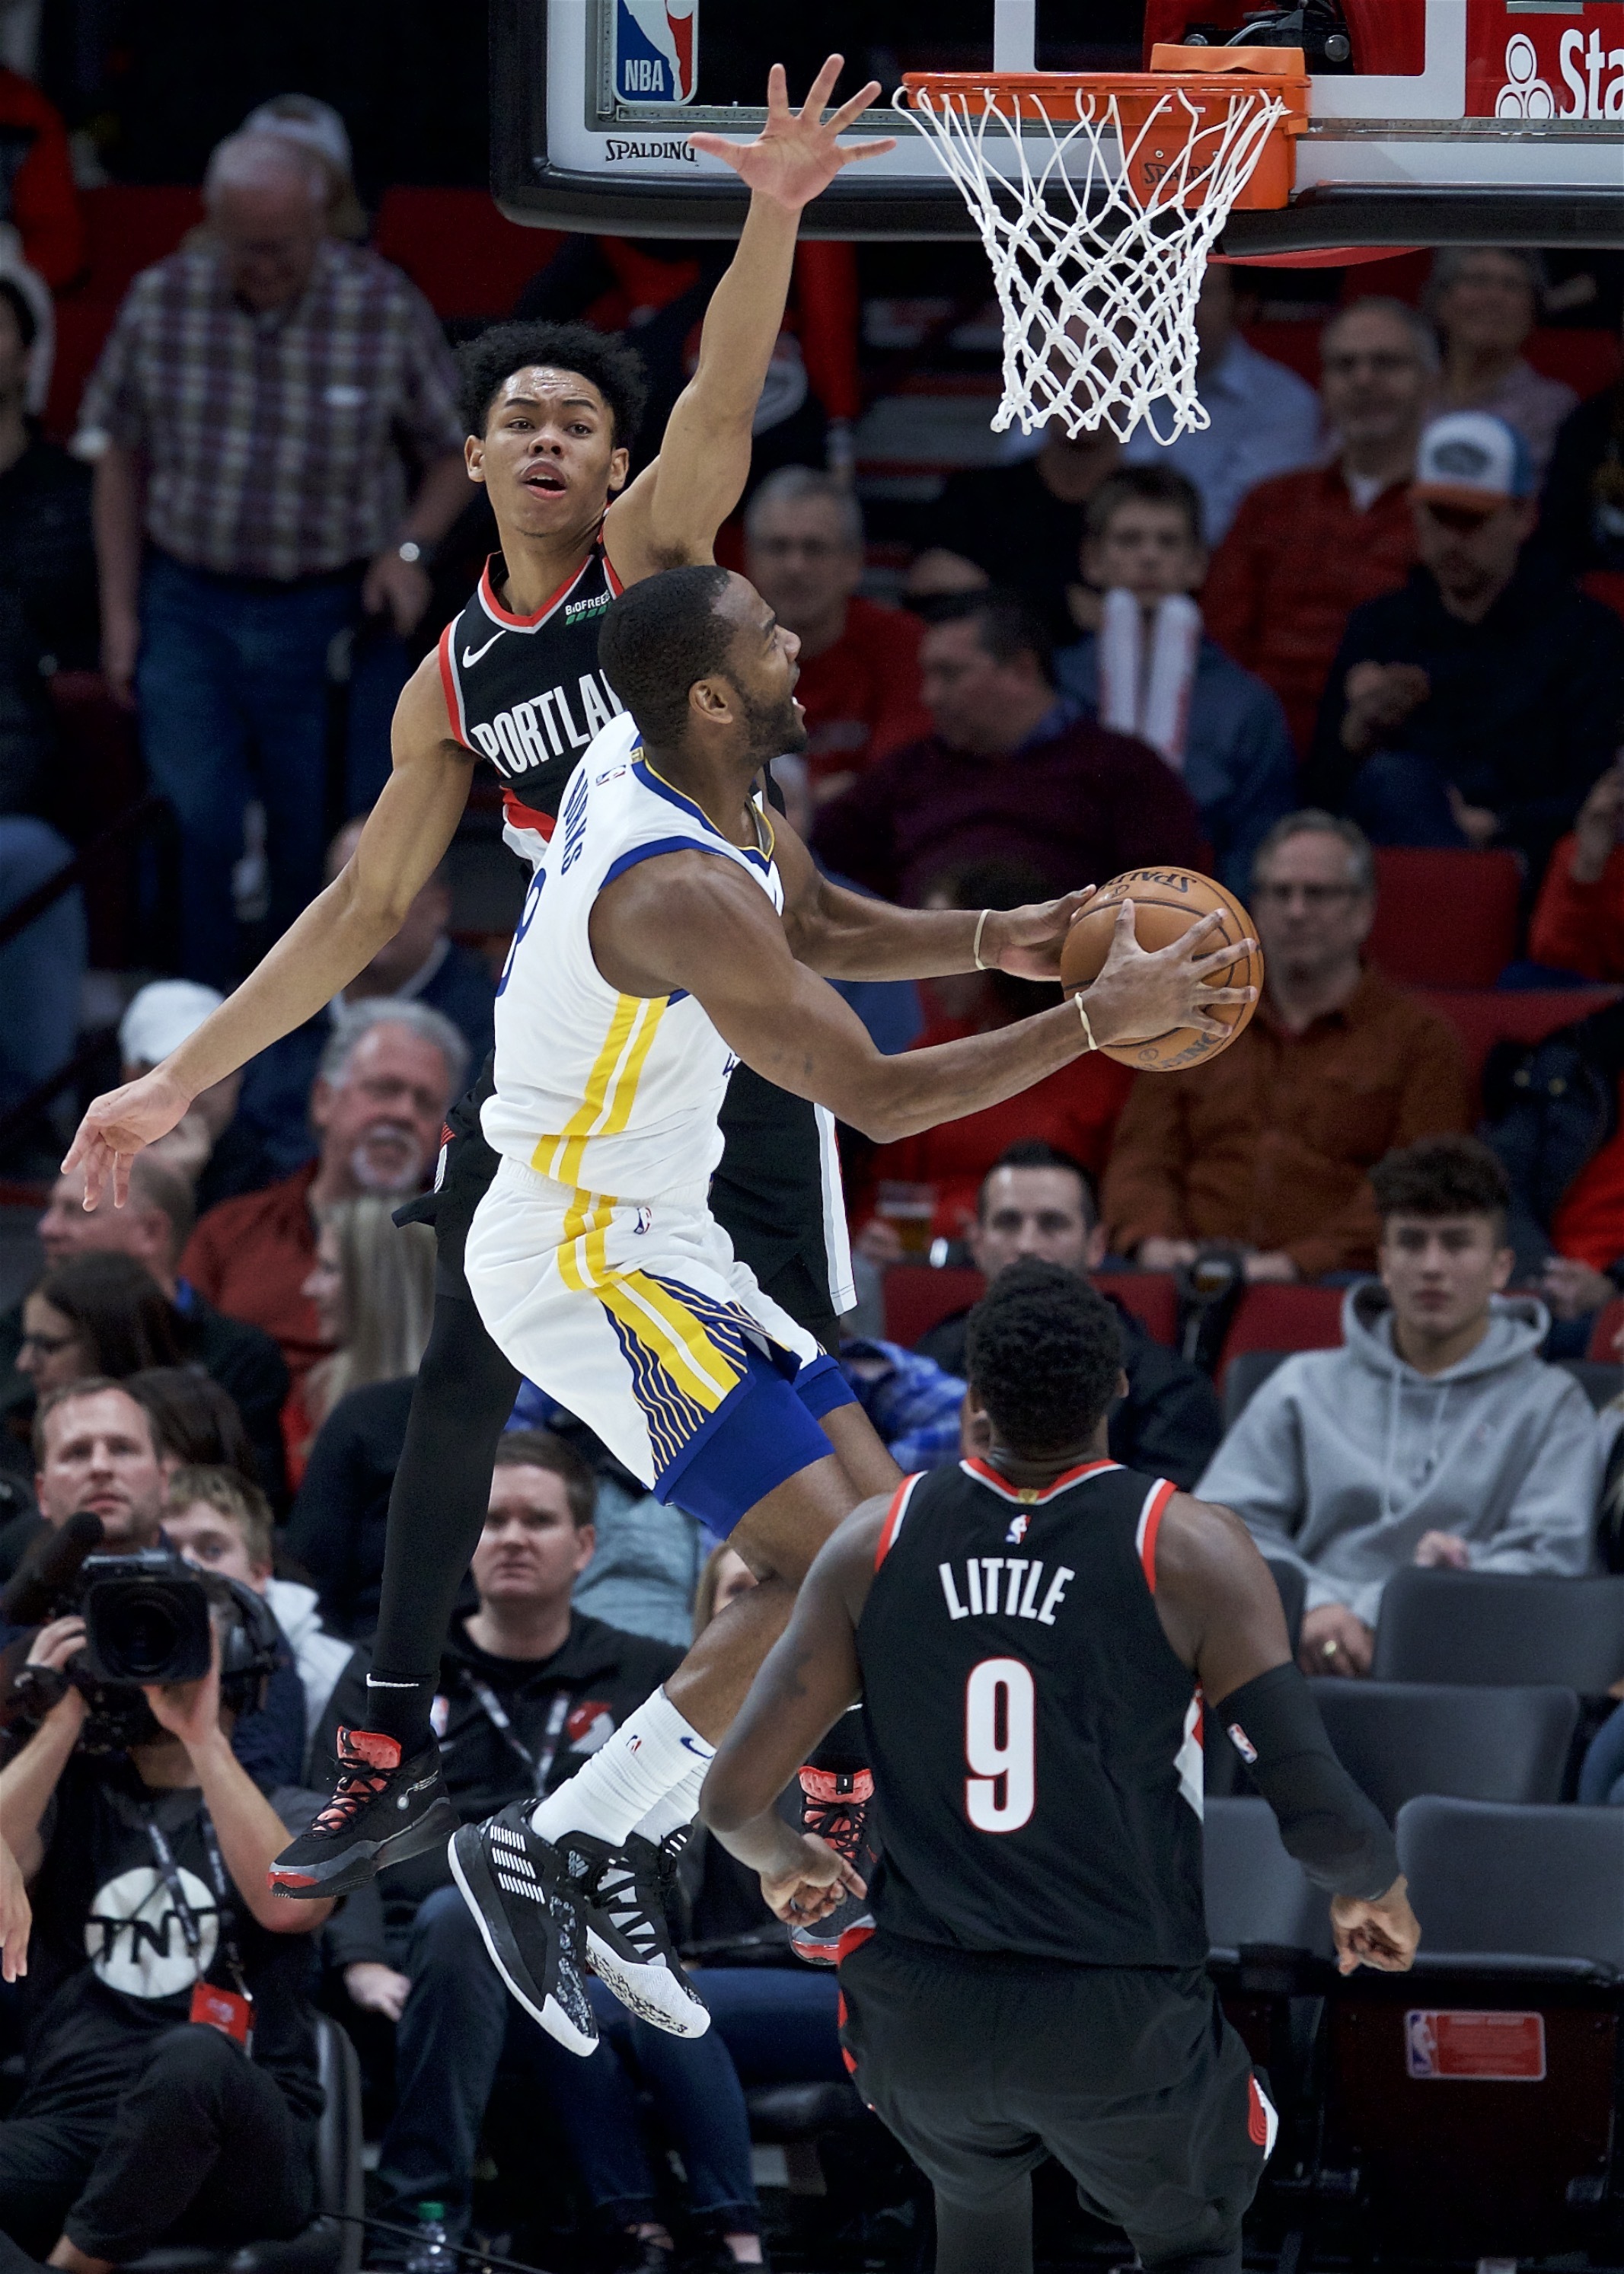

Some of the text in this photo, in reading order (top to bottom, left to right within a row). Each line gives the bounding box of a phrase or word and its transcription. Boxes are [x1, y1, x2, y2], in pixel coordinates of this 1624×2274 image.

[624, 59, 665, 91] NBA
[605, 139, 697, 162] SPALDING
[938, 1557, 1075, 1626] LITTLE
[965, 1655, 1037, 1834] 9
[82, 1906, 219, 1965] TNT
